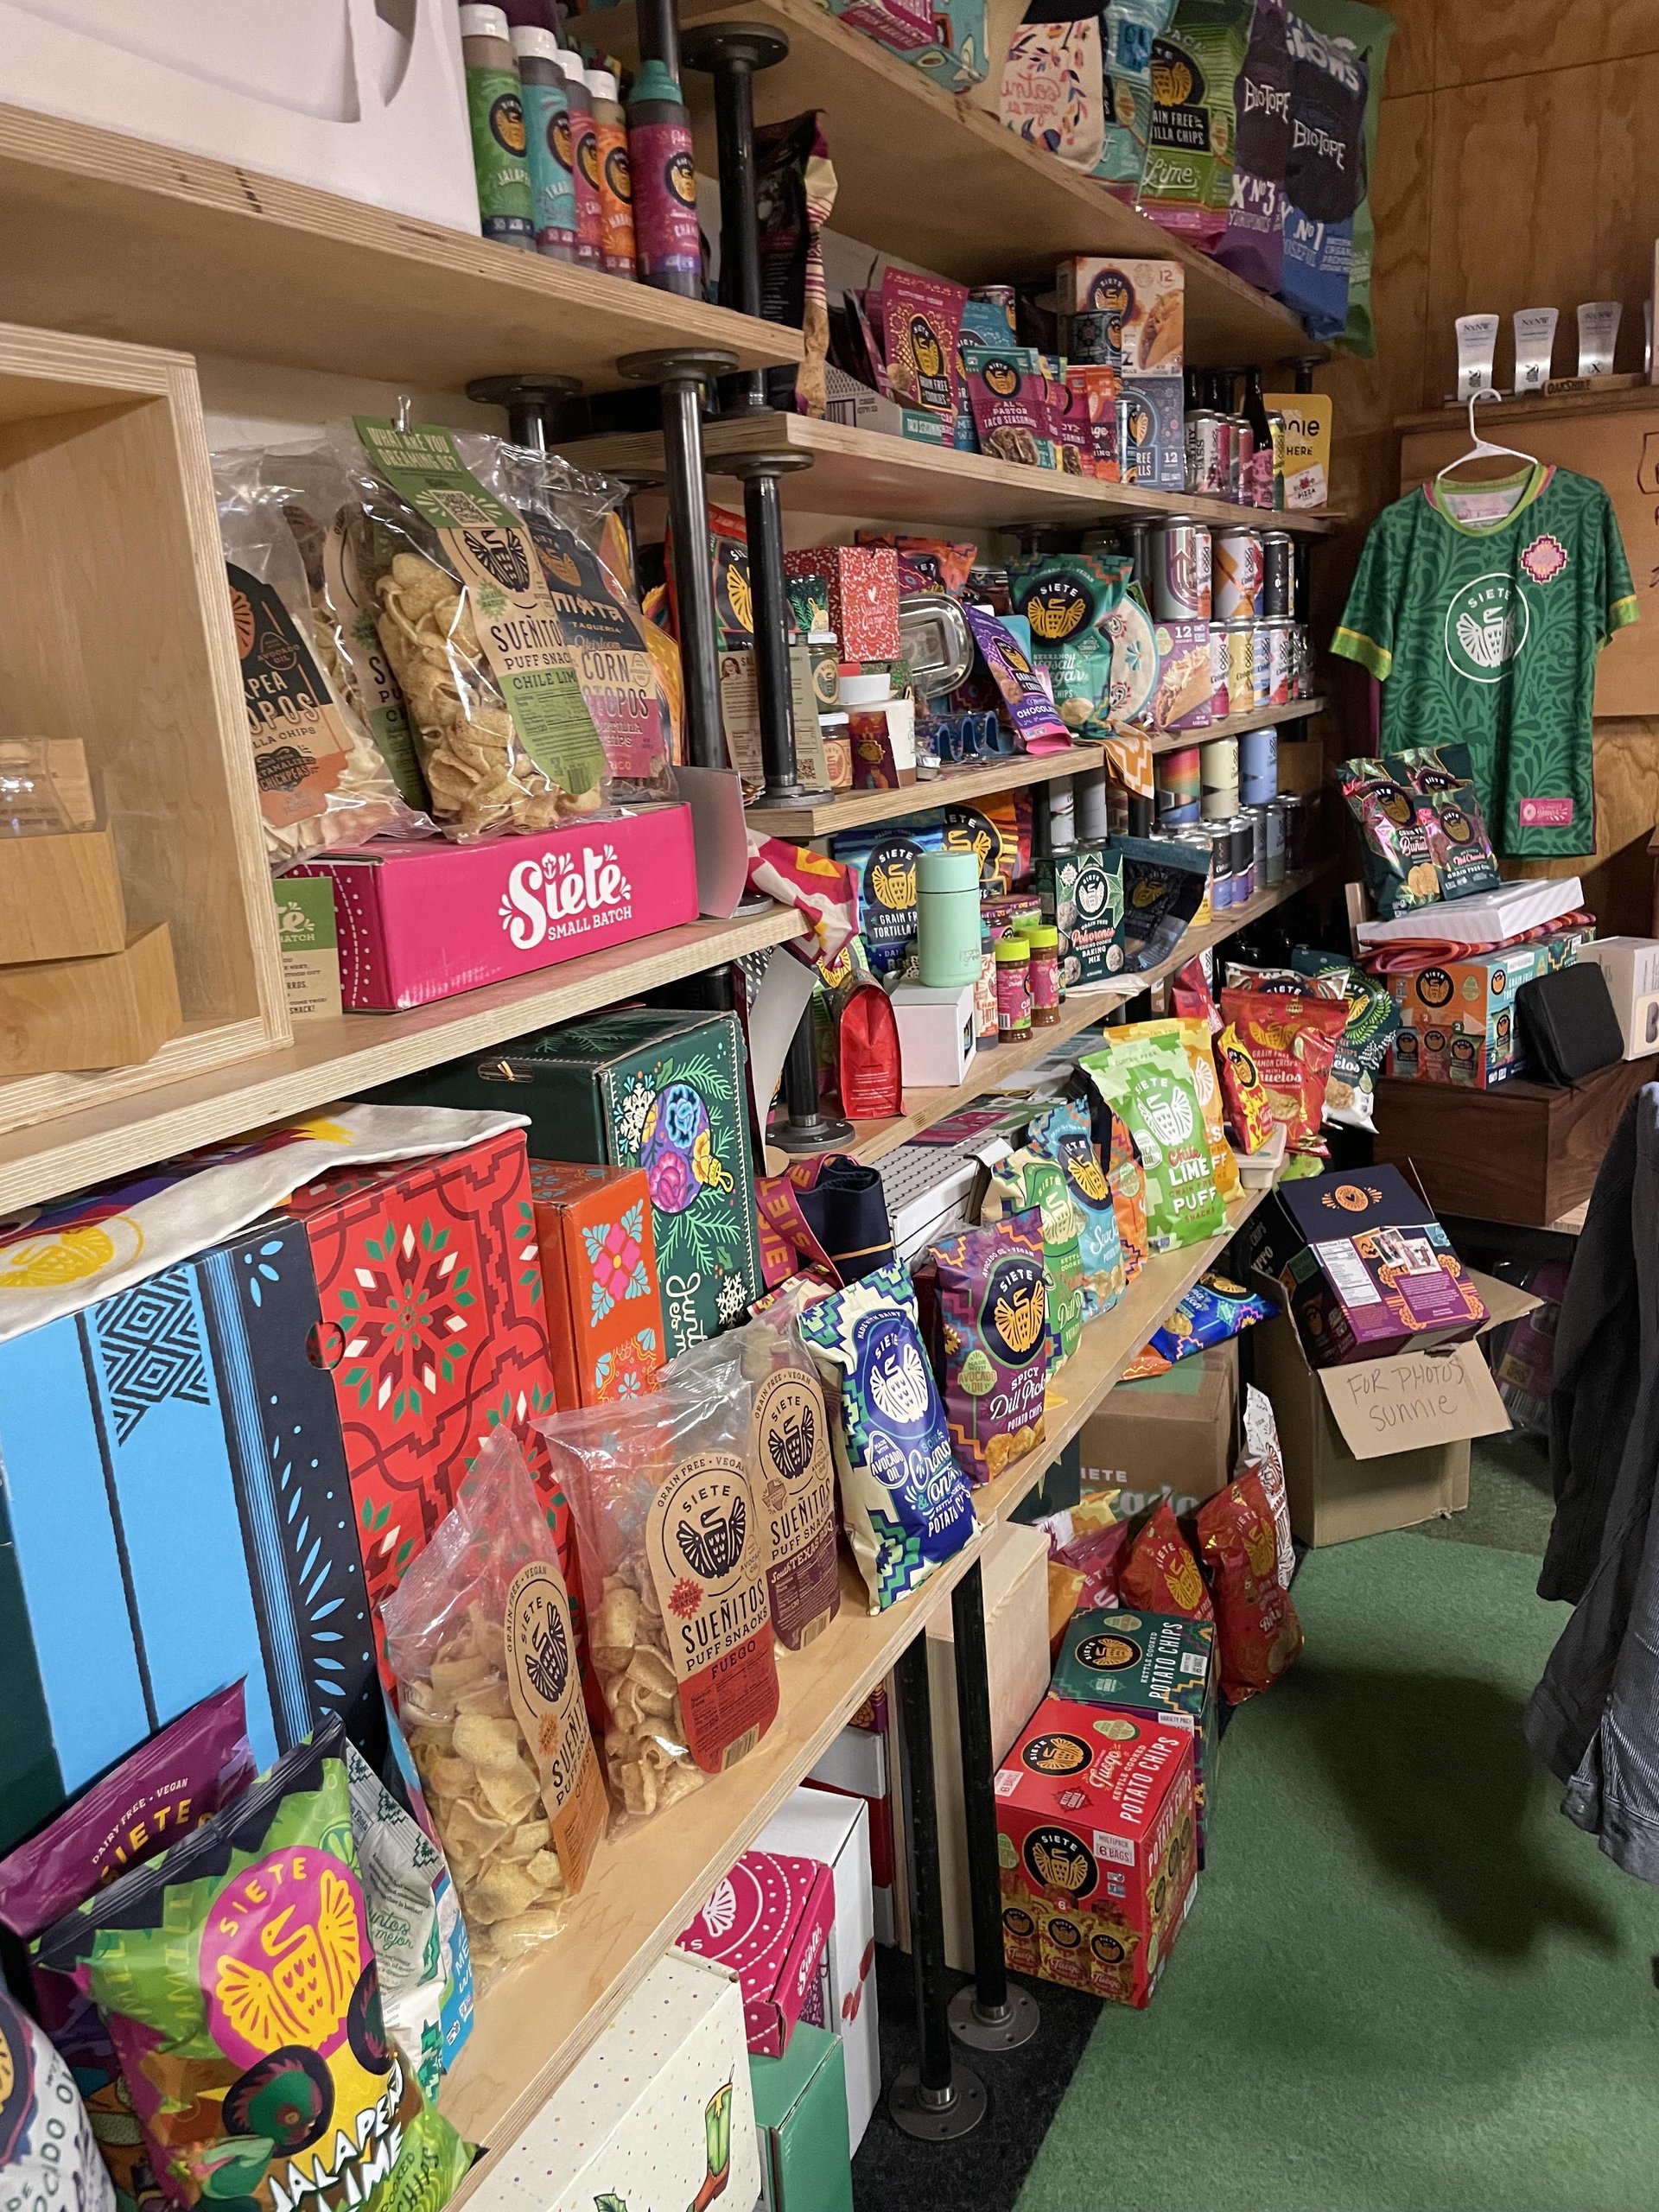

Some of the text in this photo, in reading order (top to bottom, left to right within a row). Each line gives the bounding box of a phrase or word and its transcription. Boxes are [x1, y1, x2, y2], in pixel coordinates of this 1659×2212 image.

[1172, 113, 1193, 127] FREE
[1176, 130, 1204, 145] CHIPS
[1142, 156, 1196, 190] Lime
[1159, 270, 1173, 282] 12
[983, 416, 1002, 429] TACO
[993, 407, 1027, 416] PASTOR
[365, 427, 451, 454] WHAT ARE YOU
[1286, 446, 1313, 456] HERE
[378, 448, 437, 471] DREAMING
[1164, 452, 1179, 464] 12
[1298, 488, 1317, 500] PIZZA
[1039, 583, 1079, 598] SIETE
[1467, 587, 1513, 610] SIETE
[1175, 626, 1192, 639] 12
[257, 645, 301, 663] AVOCADO
[272, 654, 291, 664] OIL
[504, 656, 540, 671] PUFF
[582, 650, 632, 683] CORN
[512, 674, 555, 690] CHILE
[278, 727, 316, 741] CHIPS
[879, 849, 914, 863] SIETE
[508, 847, 622, 950] Siete
[548, 905, 632, 942] SMALL BATCH
[879, 912, 907, 925] GRAIN
[874, 924, 912, 938] TORTILLA
[1082, 945, 1107, 958] BAKING
[1095, 938, 1112, 947] COOKIE
[1088, 956, 1101, 964] MIX
[1252, 1050, 1273, 1059] GRAIN
[1135, 1077, 1168, 1096] SIETE
[1168, 1144, 1201, 1167] Chile
[1168, 1157, 1211, 1187] LIME
[1038, 1176, 1062, 1198] SIETE
[1173, 1185, 1217, 1216] PUFF
[1185, 1207, 1216, 1224] SNACKS
[982, 1246, 1035, 1278] AVOCADO OIL VEGAN
[999, 1268, 1034, 1294] SIETE
[877, 1311, 901, 1321] DAIRY
[959, 1371, 997, 1383] AVOCADO
[1011, 1366, 1039, 1392] SPICY
[1390, 1357, 1465, 1393] PHOTOS
[754, 1371, 811, 1420] GRAIN FREE VEGAN
[970, 1382, 984, 1393] OIL
[771, 1395, 802, 1423] SIETE
[989, 1389, 1021, 1421] Dill
[1007, 1401, 1044, 1433] POTATO CHIPS
[874, 1439, 888, 1451] MADE
[876, 1444, 890, 1456] WITH
[871, 1449, 904, 1477] AVOCADO
[657, 1474, 680, 1509] GRAIN
[679, 1458, 707, 1478] FREE
[887, 1470, 902, 1484] OIL
[683, 1484, 732, 1513] SIETE
[917, 1495, 929, 1510] &
[770, 1477, 831, 1547] SUEÑITOS
[771, 1505, 831, 1561] PUFF SNACKS
[771, 1561, 792, 1585] South
[789, 1538, 820, 1571] TEXAS
[1156, 1541, 1176, 1570] SIETE
[506, 1566, 548, 1654] GRAIN FREE VEGAN
[520, 1596, 543, 1645] SIETE
[681, 1578, 766, 1656] SUEÑITOS
[685, 1605, 768, 1673] PUFF SNACKS
[710, 1640, 757, 1680] FUEGO
[1084, 1641, 1096, 1662] SIETE
[1140, 1631, 1158, 1684] KETTLE COOKED
[1148, 1621, 1184, 1700] POTATO CHIPS
[1029, 1738, 1048, 1761] SIETE
[1088, 1750, 1122, 1789] Fuego
[1112, 1744, 1147, 1802] KETTLE COOKED
[1120, 1736, 1181, 1825] POTATO CHIPS
[92, 1777, 188, 1865] DAIRY FREE VEGAN
[1040, 1834, 1078, 1852] SIETE
[1098, 1834, 1129, 1848] MULTIPACK
[1098, 1847, 1130, 1863] 6 BAGS
[219, 1856, 308, 1938] SIETE
[1058, 1900, 1066, 1910] 6
[375, 1930, 414, 1951] mejor
